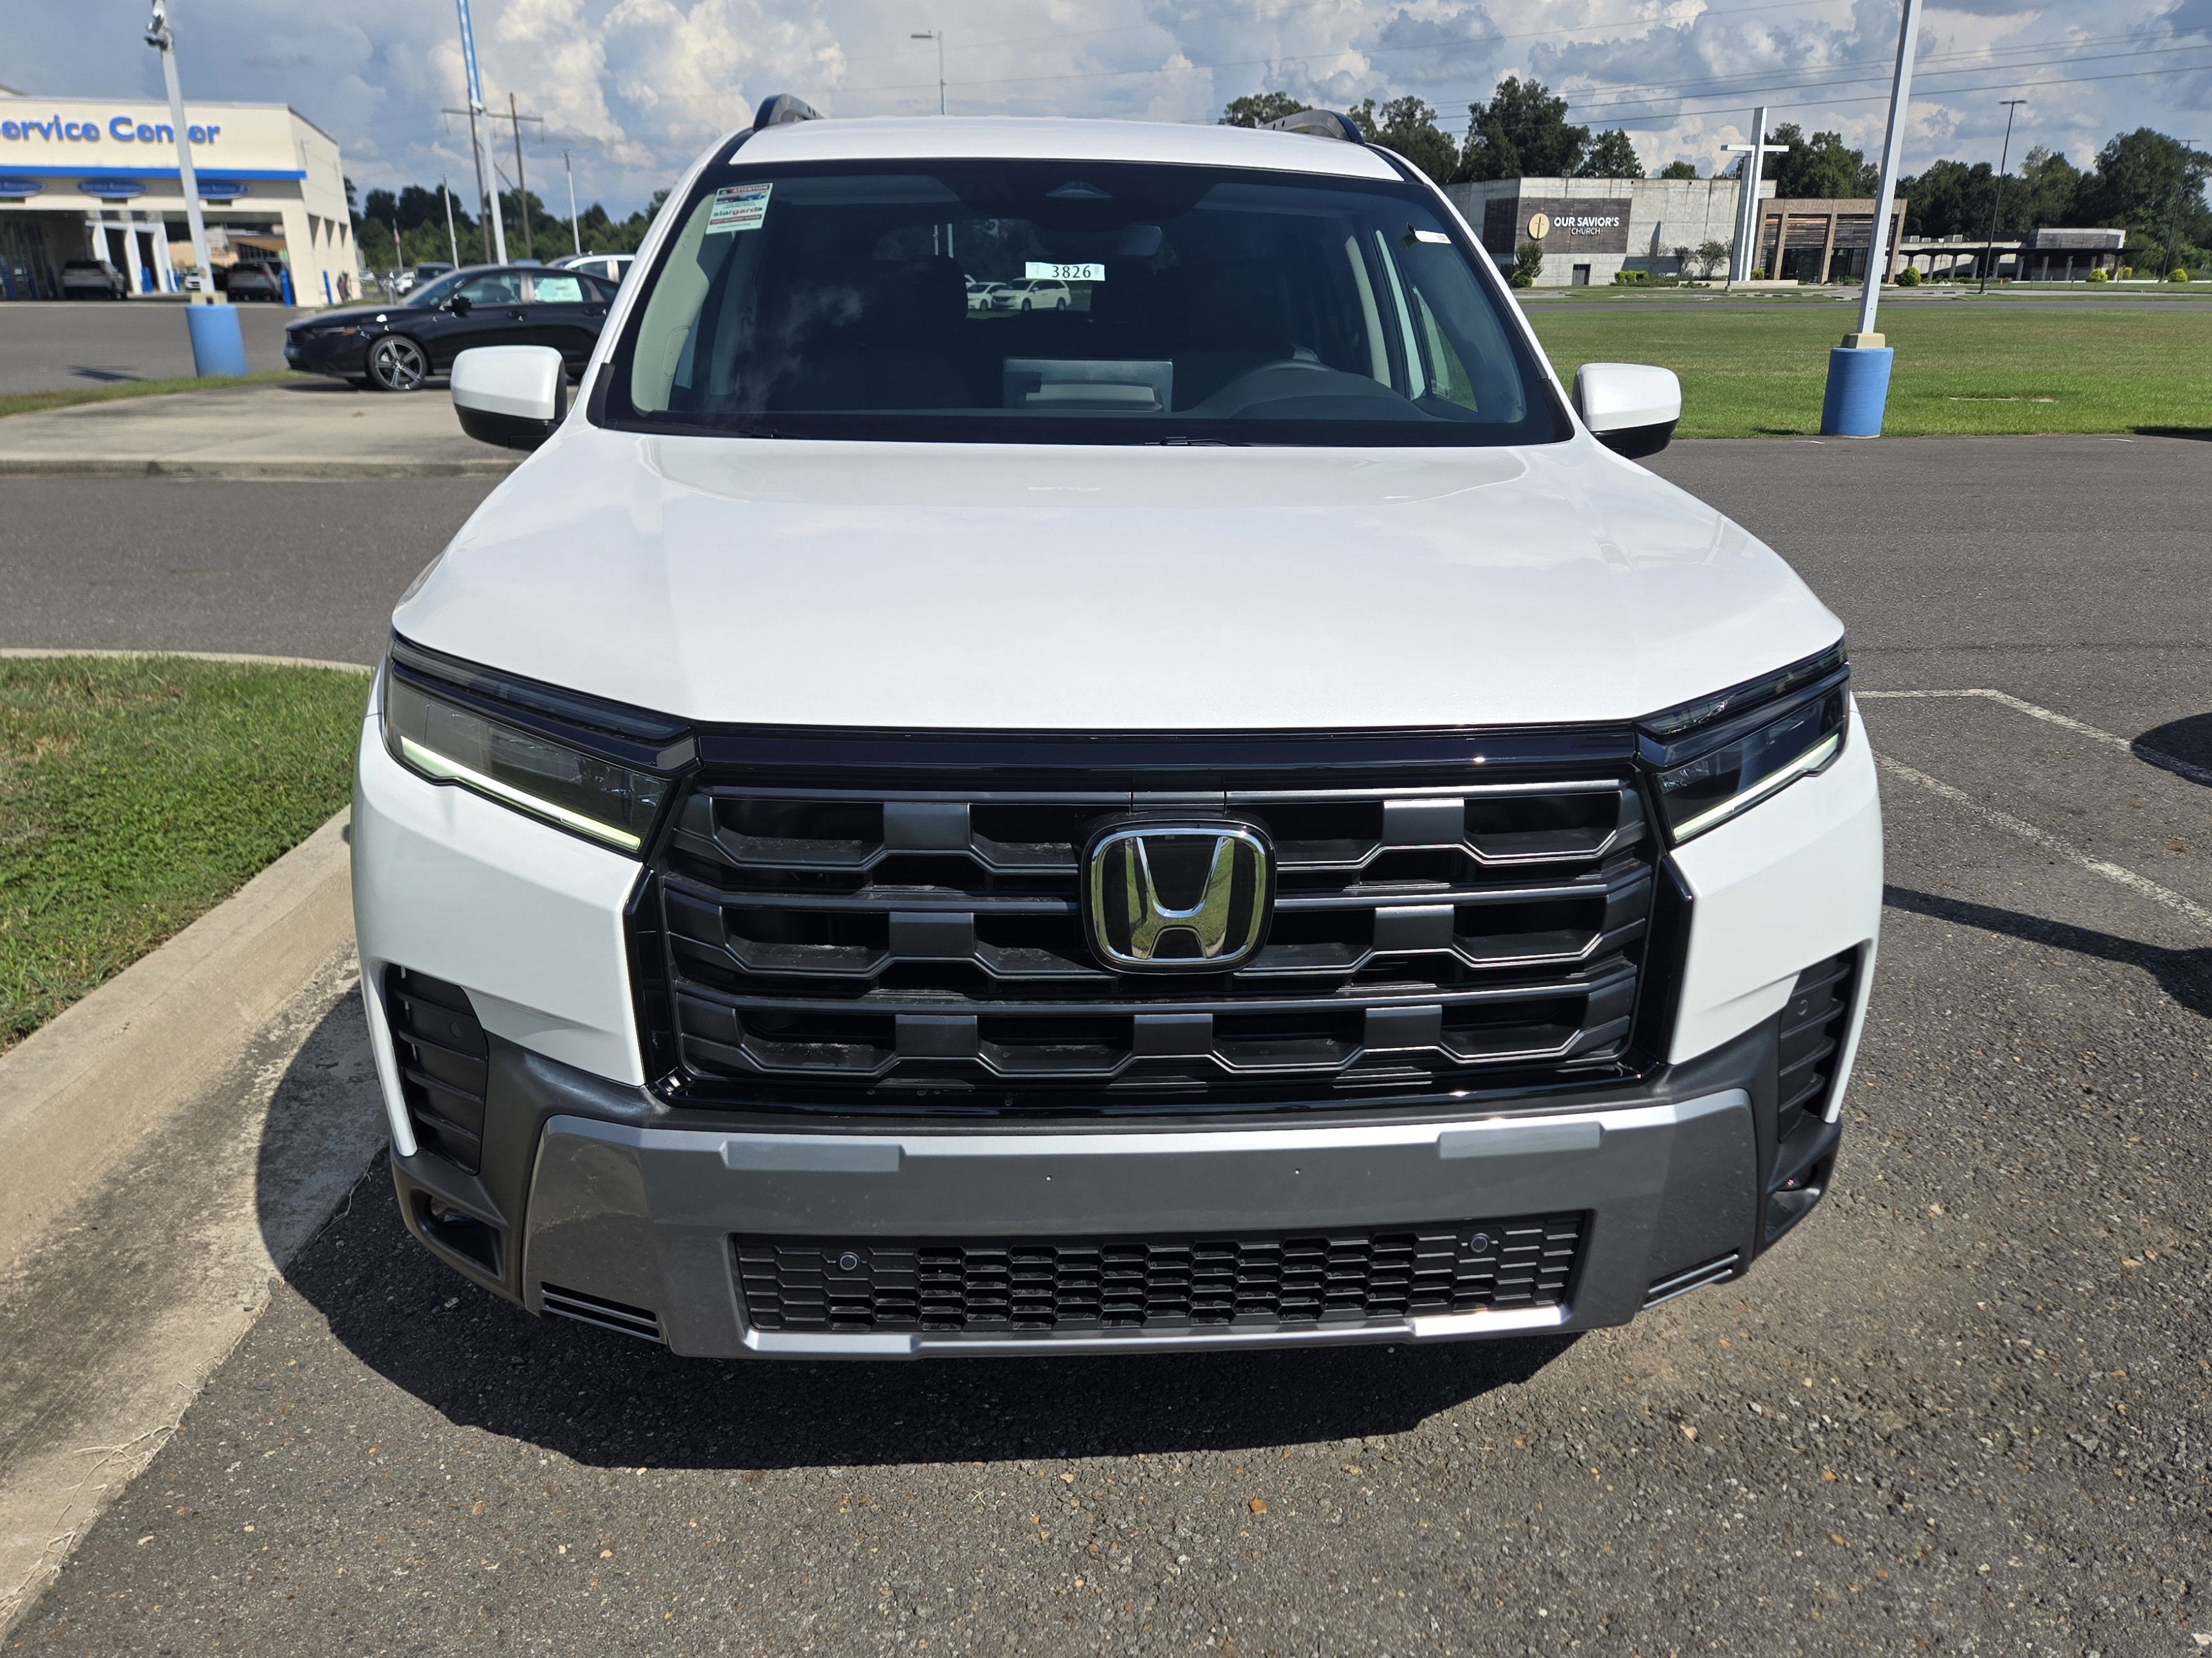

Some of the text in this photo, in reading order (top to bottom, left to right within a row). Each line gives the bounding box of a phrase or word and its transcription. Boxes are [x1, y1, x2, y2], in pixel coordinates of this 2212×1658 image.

[0, 114, 220, 143] ervice Cener
[1554, 216, 1619, 227] OUR SAVIOR'S
[1052, 265, 1091, 278] 3826
